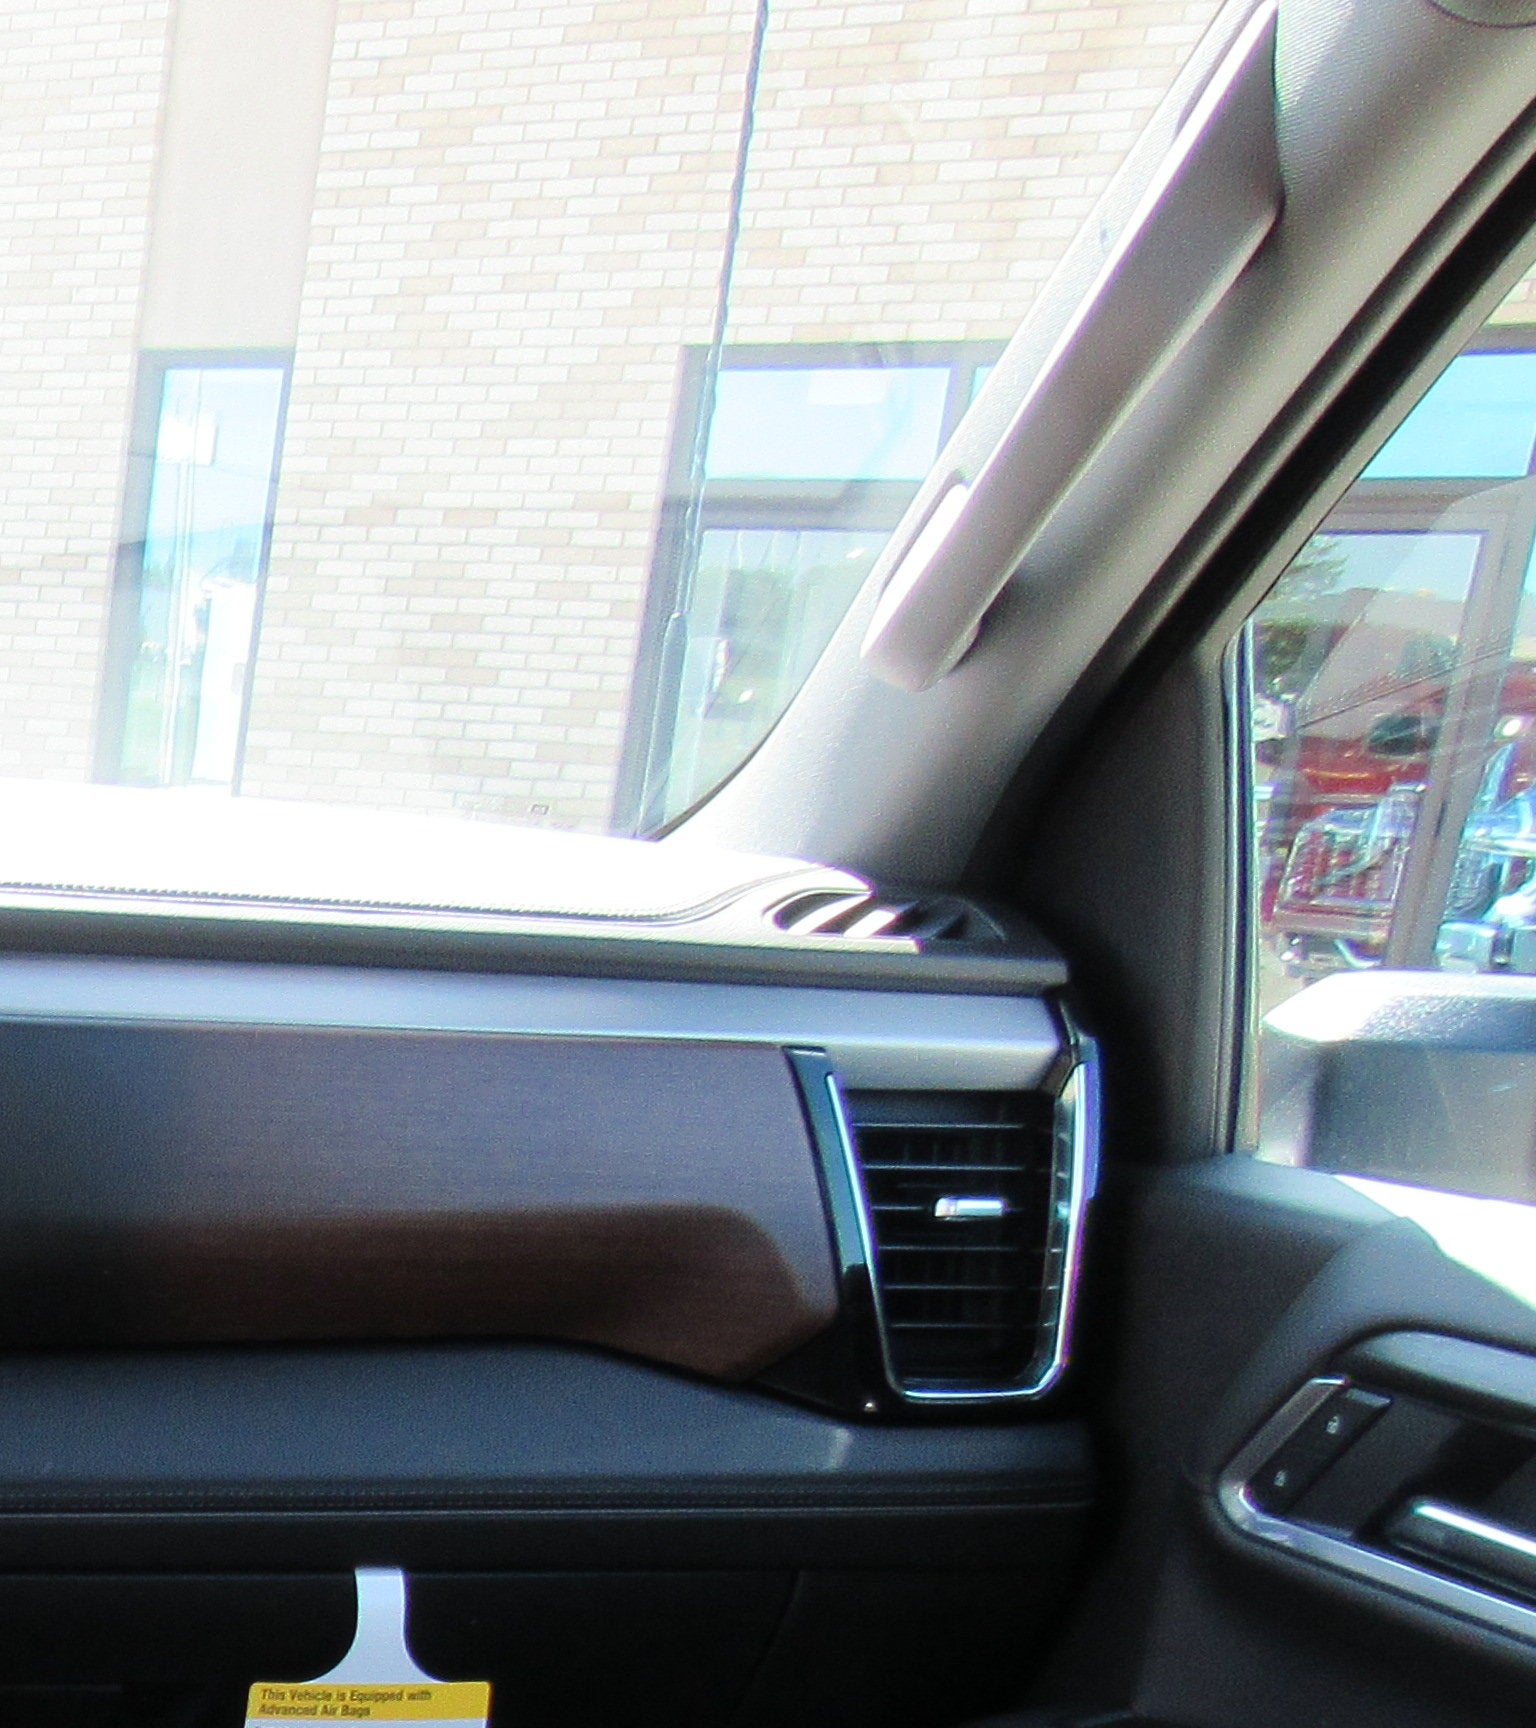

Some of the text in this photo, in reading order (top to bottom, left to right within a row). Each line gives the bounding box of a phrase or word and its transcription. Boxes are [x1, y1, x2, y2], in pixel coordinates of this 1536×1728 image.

[261, 1689, 432, 1704] This Vehicle is Equipped with
[258, 1704, 371, 1718] Advanced Air Bags
